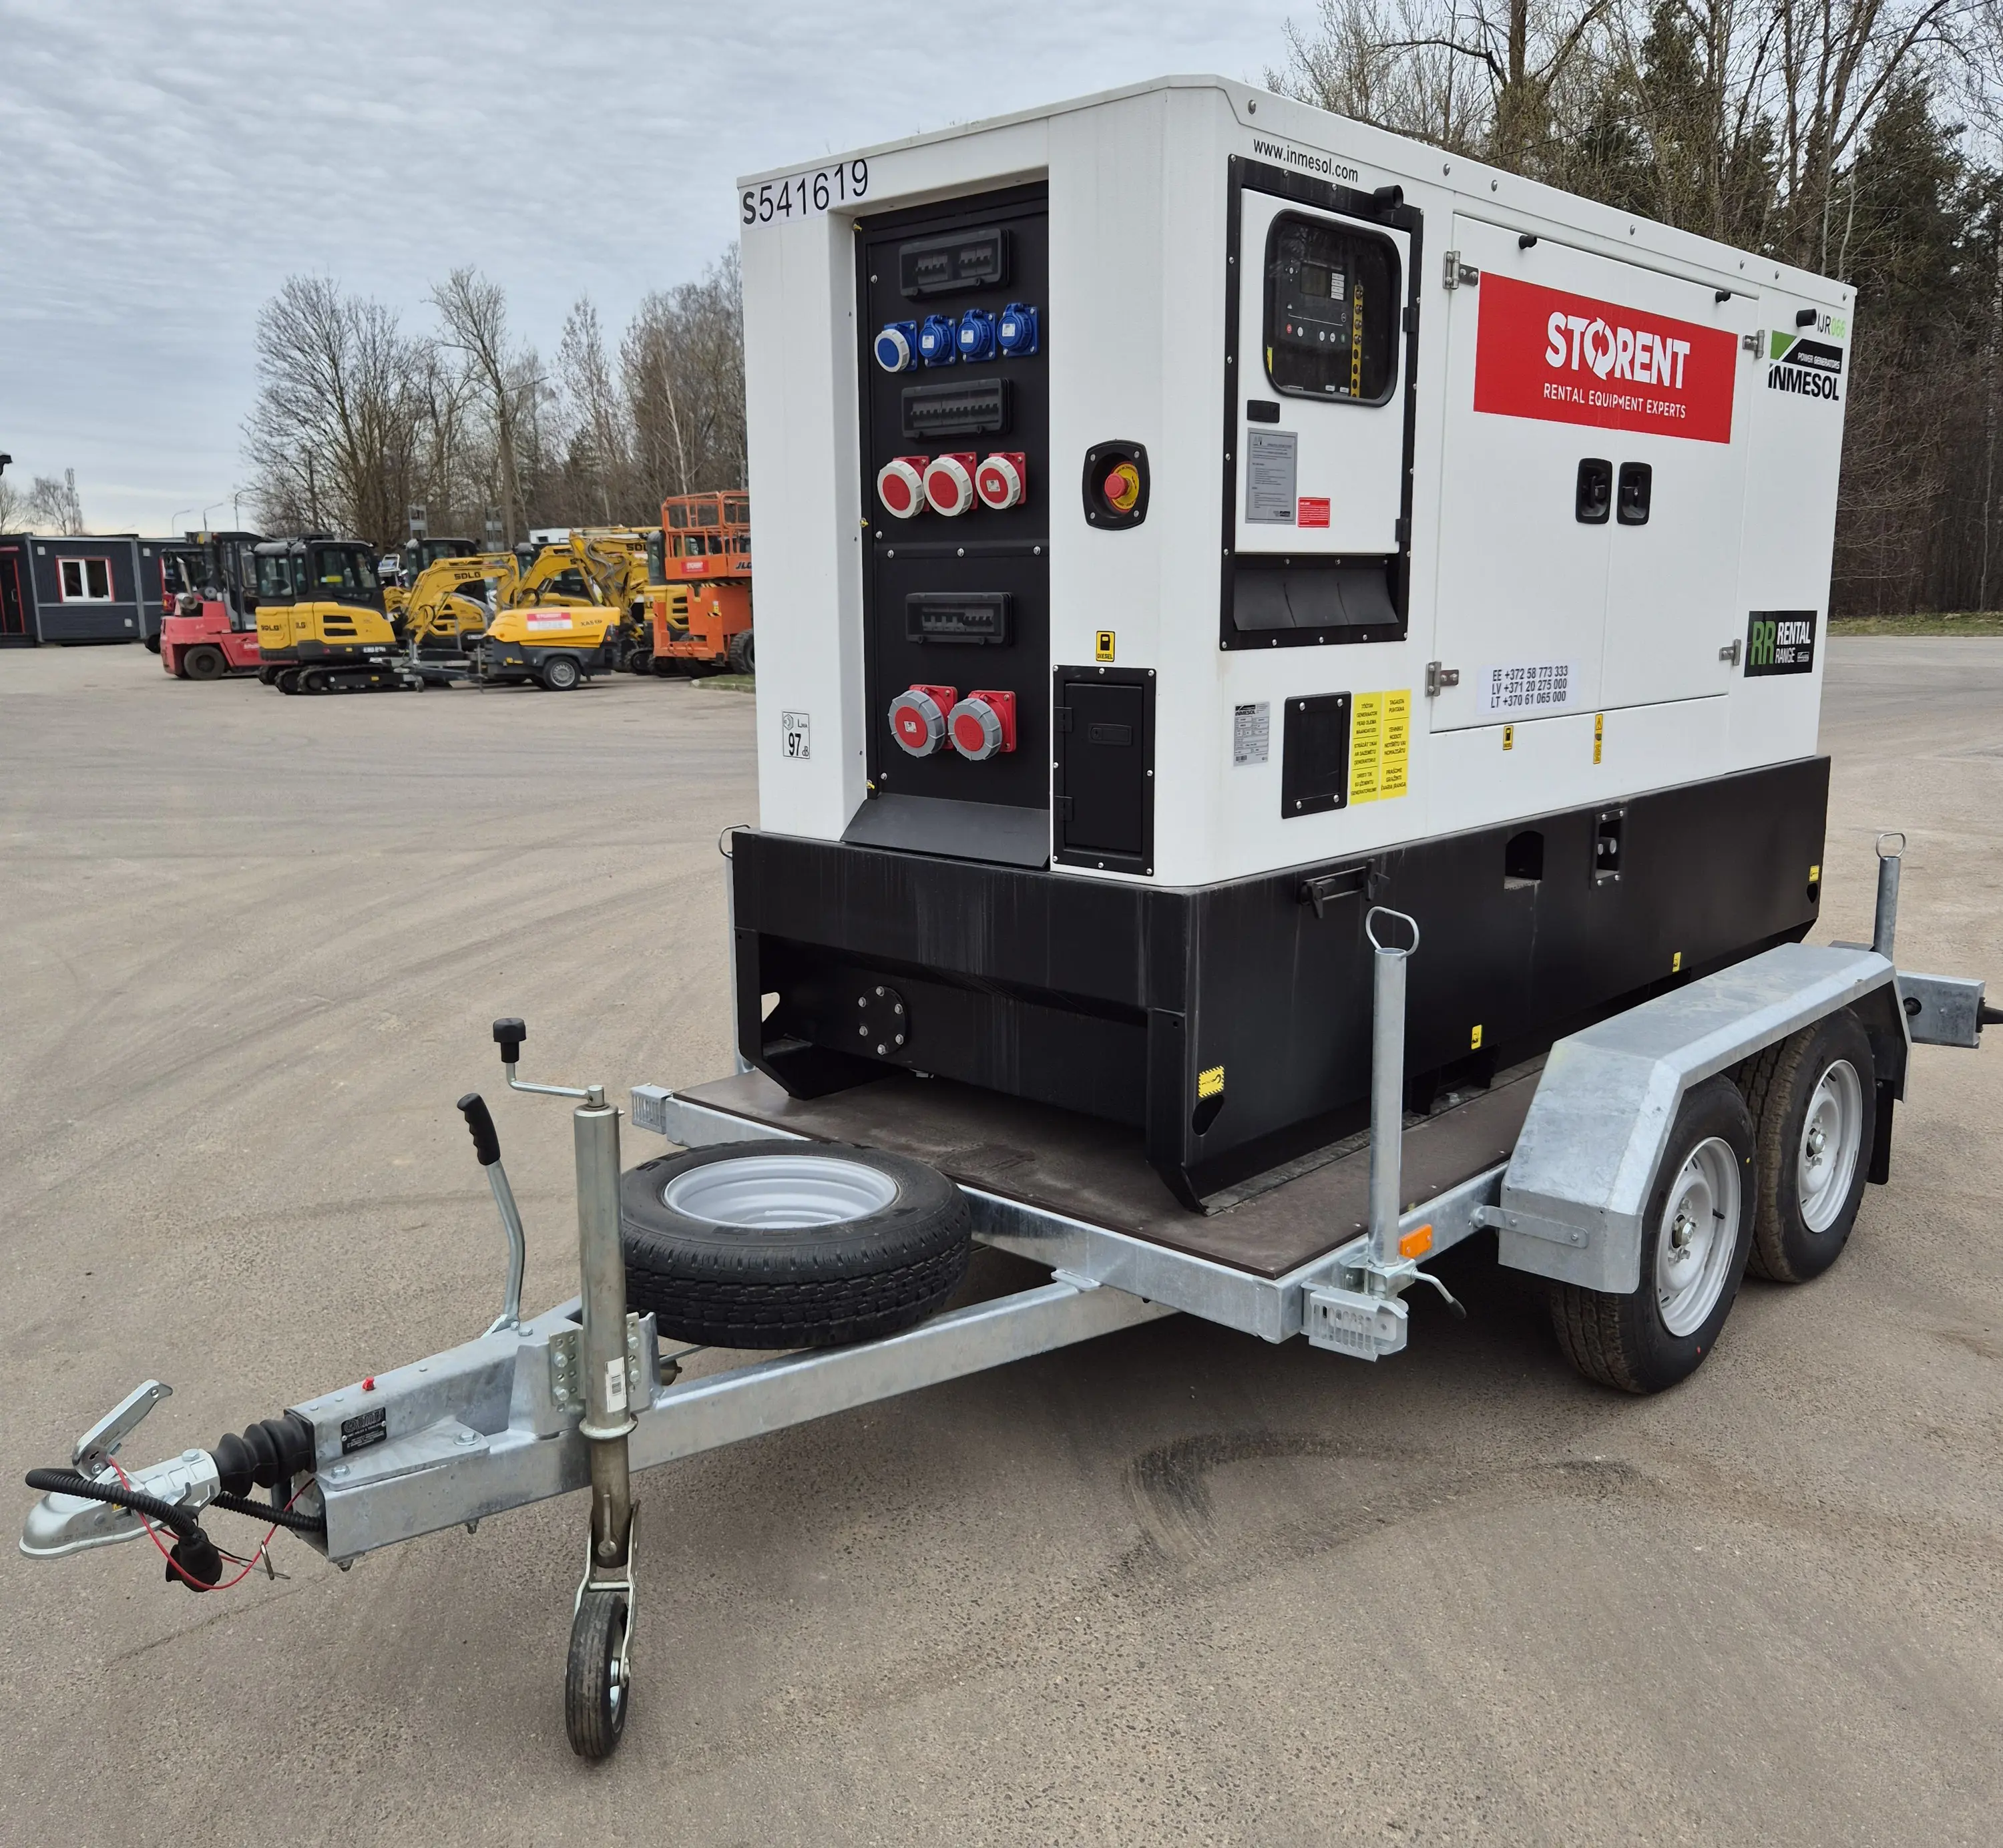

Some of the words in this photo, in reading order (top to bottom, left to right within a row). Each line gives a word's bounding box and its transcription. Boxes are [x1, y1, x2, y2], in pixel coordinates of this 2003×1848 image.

[1253, 138, 1358, 182] www.inmesol.com
[742, 158, 868, 224] S541619
[1545, 311, 1691, 389] STORENT
[1797, 352, 1813, 363] POWER
[1814, 356, 1841, 369] GENERATORS
[1768, 363, 1839, 401] INMESOL
[1544, 383, 1585, 404] RENTAL
[1588, 390, 1644, 412] EQUIPMENT
[1646, 399, 1687, 419] EXPERTS
[454, 571, 481, 580] SDLG
[1751, 620, 1776, 666] RR
[1777, 621, 1811, 645] RENTAL
[1775, 647, 1796, 664] RANGE
[1492, 669, 1502, 682] EE
[1505, 668, 1524, 680] +372
[1526, 667, 1536, 679] 58
[1538, 666, 1552, 678] 773
[1554, 665, 1568, 677] 333
[1492, 682, 1502, 695] LV
[1504, 681, 1523, 693] +371
[1526, 680, 1536, 692] 20
[1538, 679, 1552, 691] 275
[1553, 678, 1567, 690] 000
[1490, 696, 1501, 708] LT
[1503, 694, 1522, 706] +370
[1524, 693, 1534, 705] 61
[1536, 692, 1550, 704] 065
[1552, 690, 1566, 702] 000
[789, 732, 801, 756] 97
